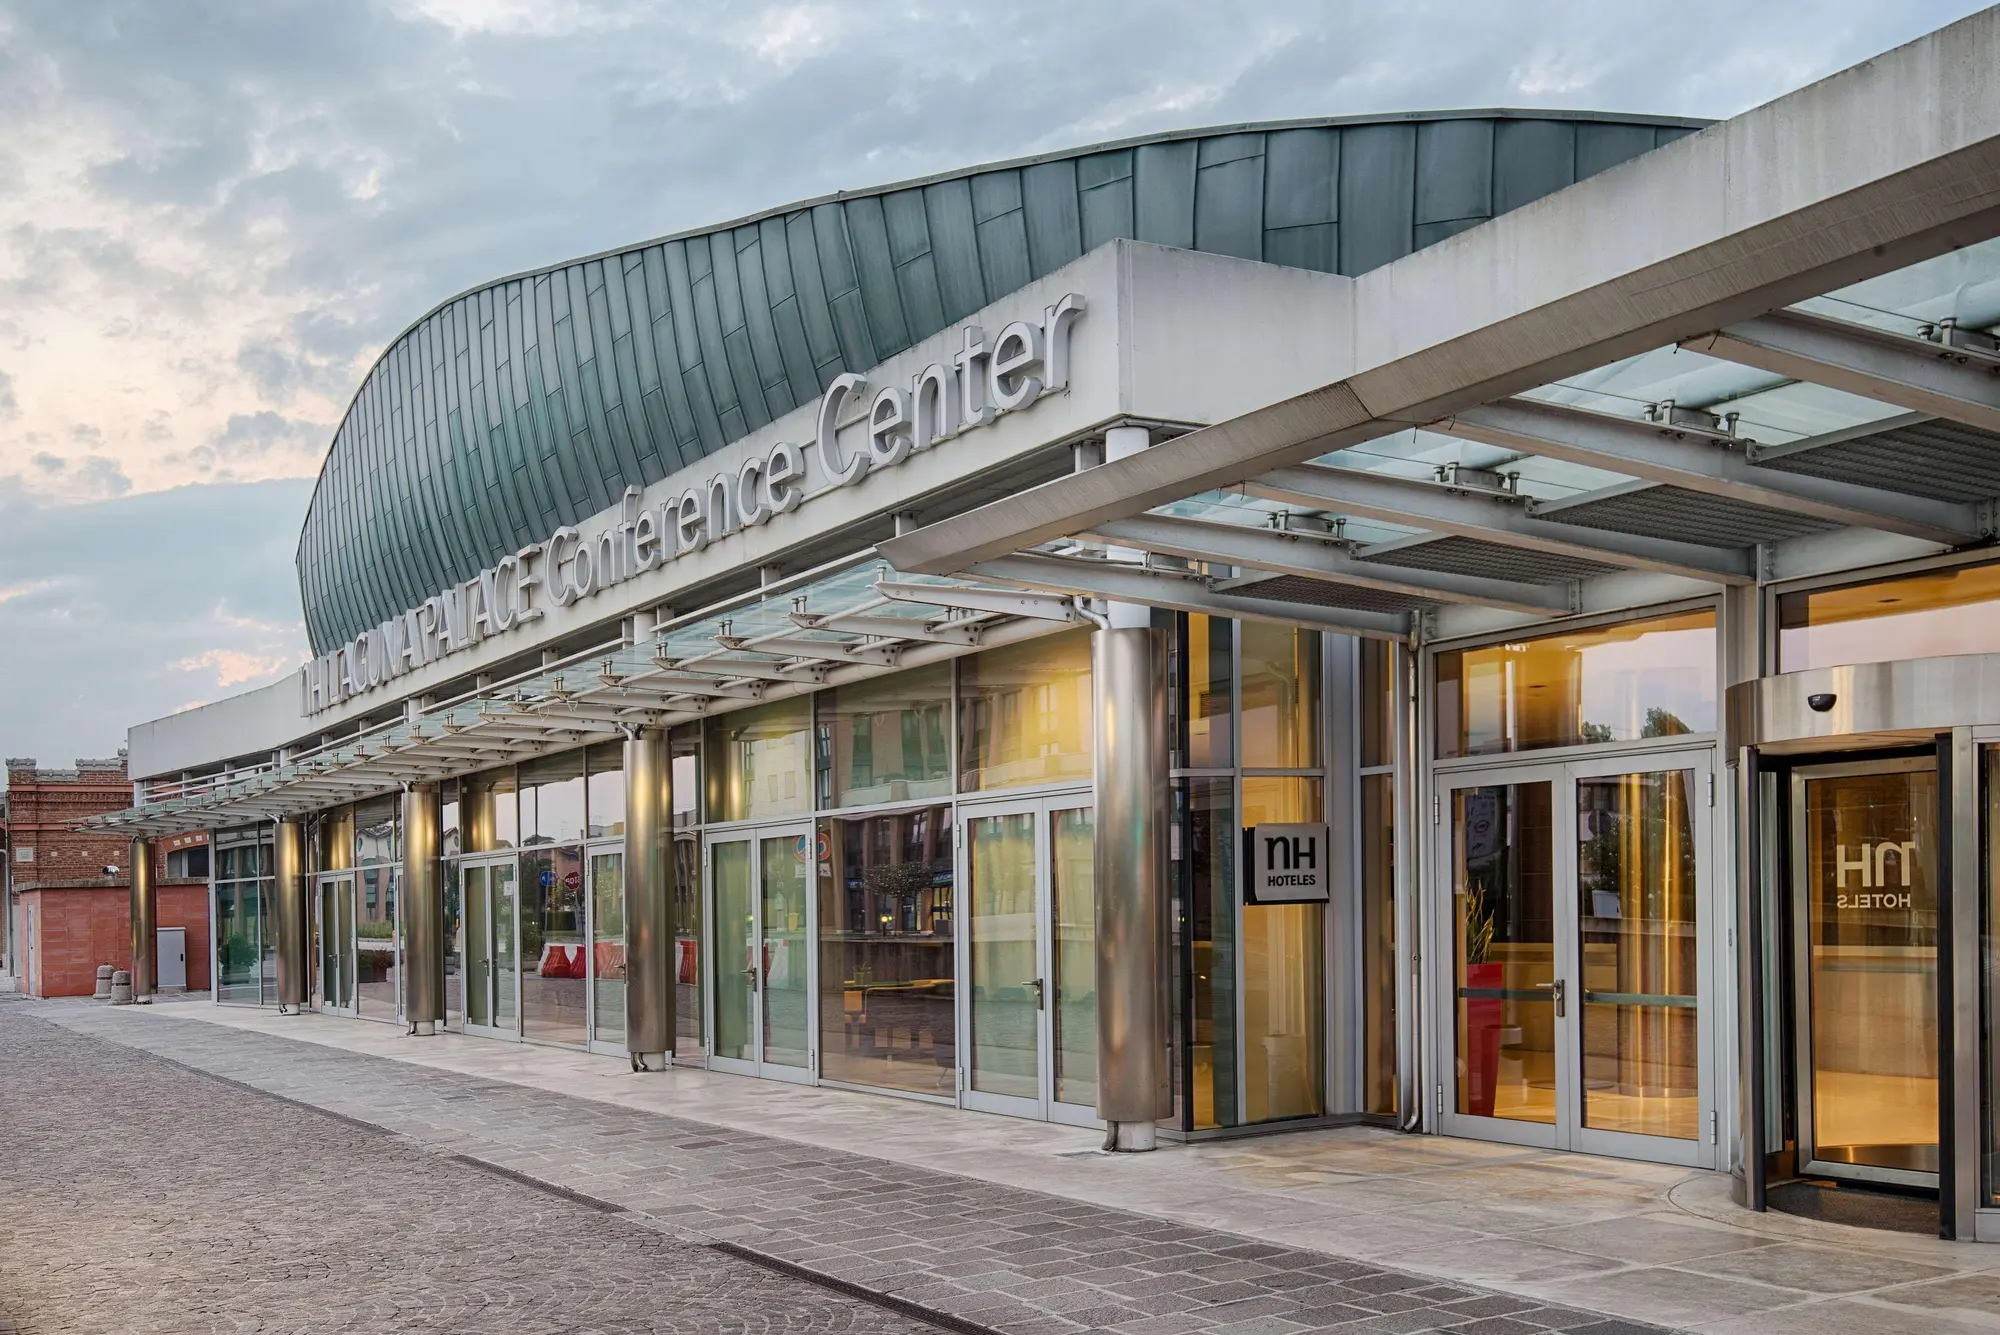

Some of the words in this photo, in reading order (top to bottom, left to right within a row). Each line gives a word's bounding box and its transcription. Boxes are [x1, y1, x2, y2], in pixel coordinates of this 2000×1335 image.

[328, 608, 427, 708] LAGUNA
[424, 543, 545, 666] PALACE
[545, 441, 804, 608] Conference
[815, 292, 1086, 487] Center
[1268, 874, 1317, 887] HOTELES
